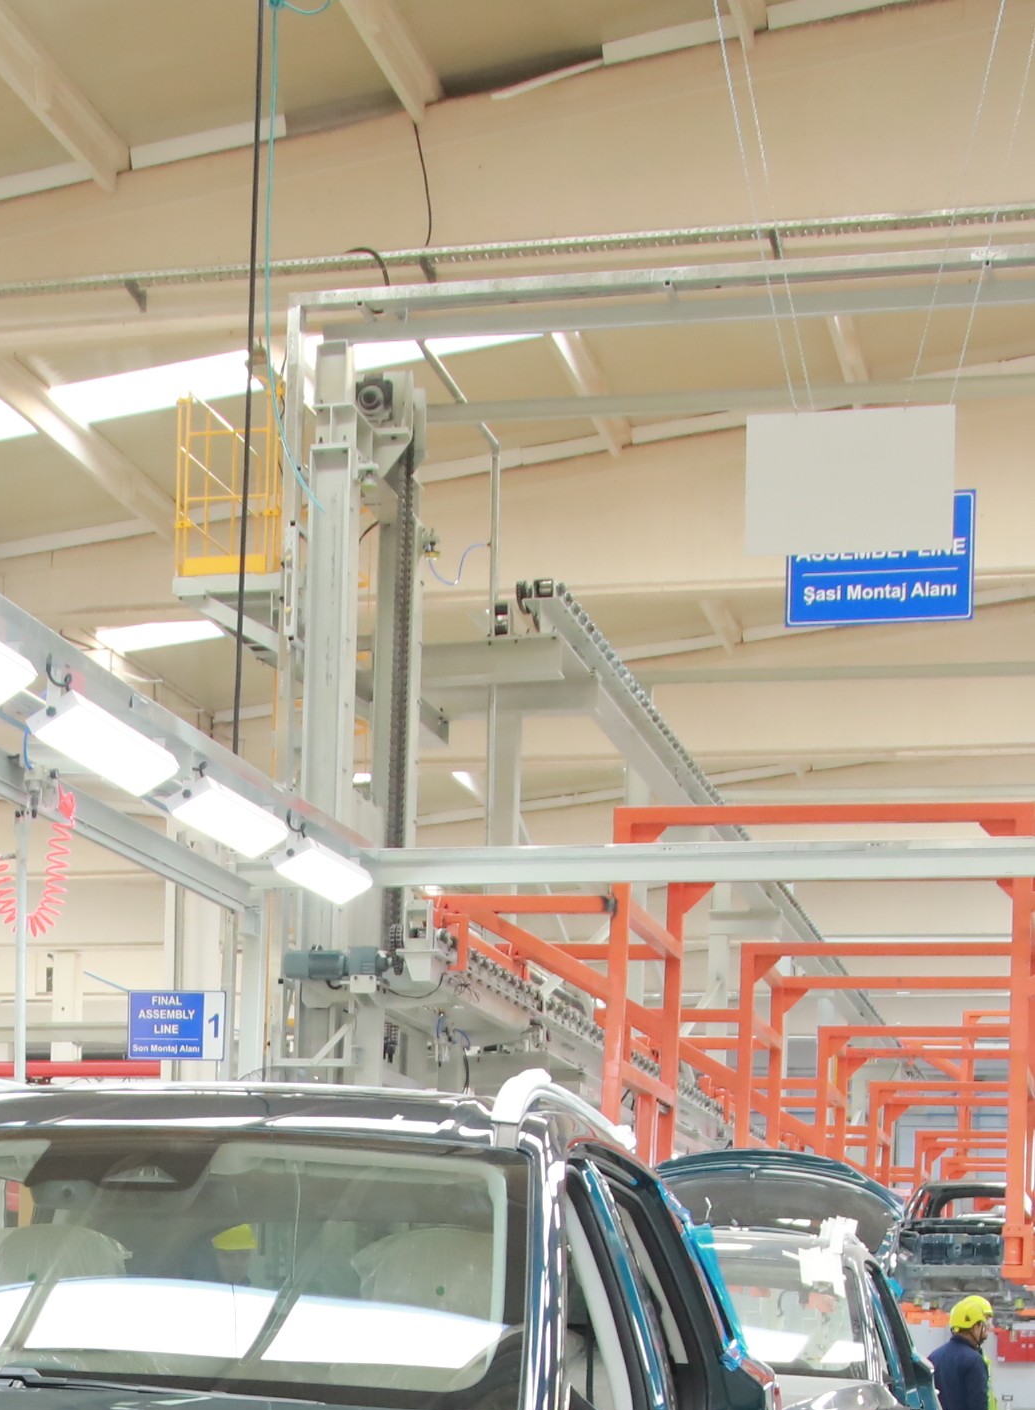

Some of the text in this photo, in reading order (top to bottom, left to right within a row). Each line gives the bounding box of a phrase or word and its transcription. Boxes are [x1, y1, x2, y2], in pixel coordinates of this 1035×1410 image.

[803, 581, 958, 606] Şasi Montaj Alanı
[151, 995, 182, 1005] FINAL
[138, 1009, 195, 1019] ASSEMBLY
[153, 1024, 179, 1034] LINE
[208, 1013, 220, 1038] 1
[132, 1044, 149, 1053] Son
[150, 1044, 178, 1054] Montaj
